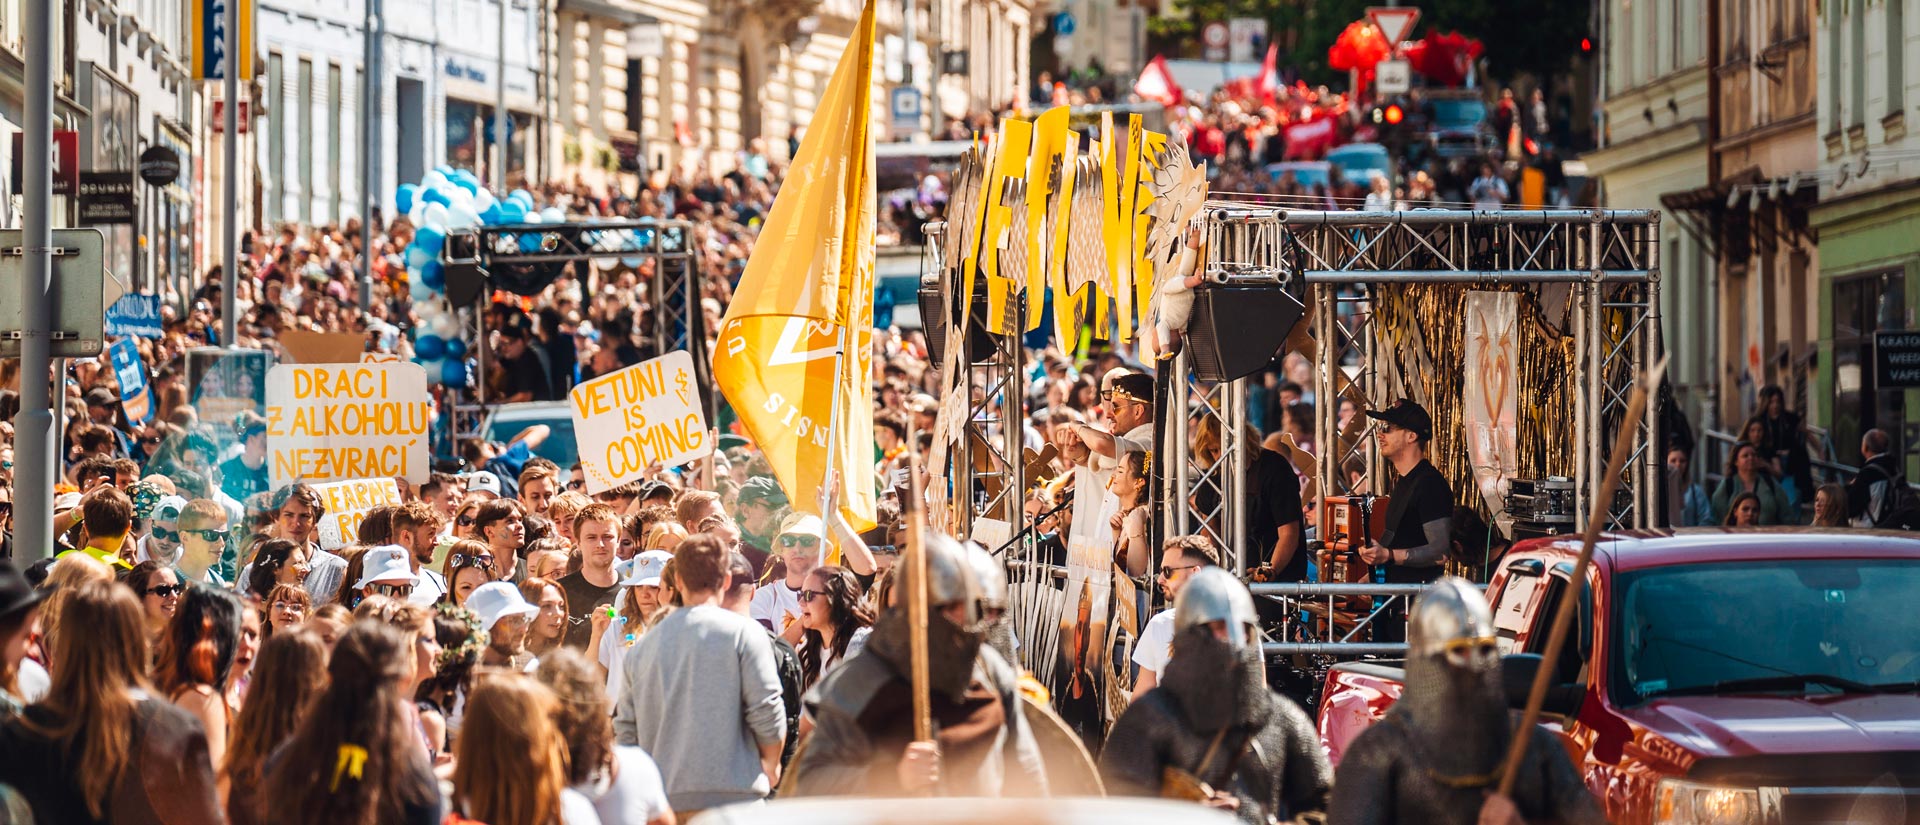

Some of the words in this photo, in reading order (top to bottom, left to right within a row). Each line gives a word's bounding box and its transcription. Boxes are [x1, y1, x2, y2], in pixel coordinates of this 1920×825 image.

[572, 361, 666, 419] VETUNI
[266, 406, 284, 436] Z
[289, 402, 427, 437] ALKOHOLU
[623, 404, 646, 432] IS
[274, 439, 417, 480] NEZVRACÍ
[606, 413, 703, 478] COMING
